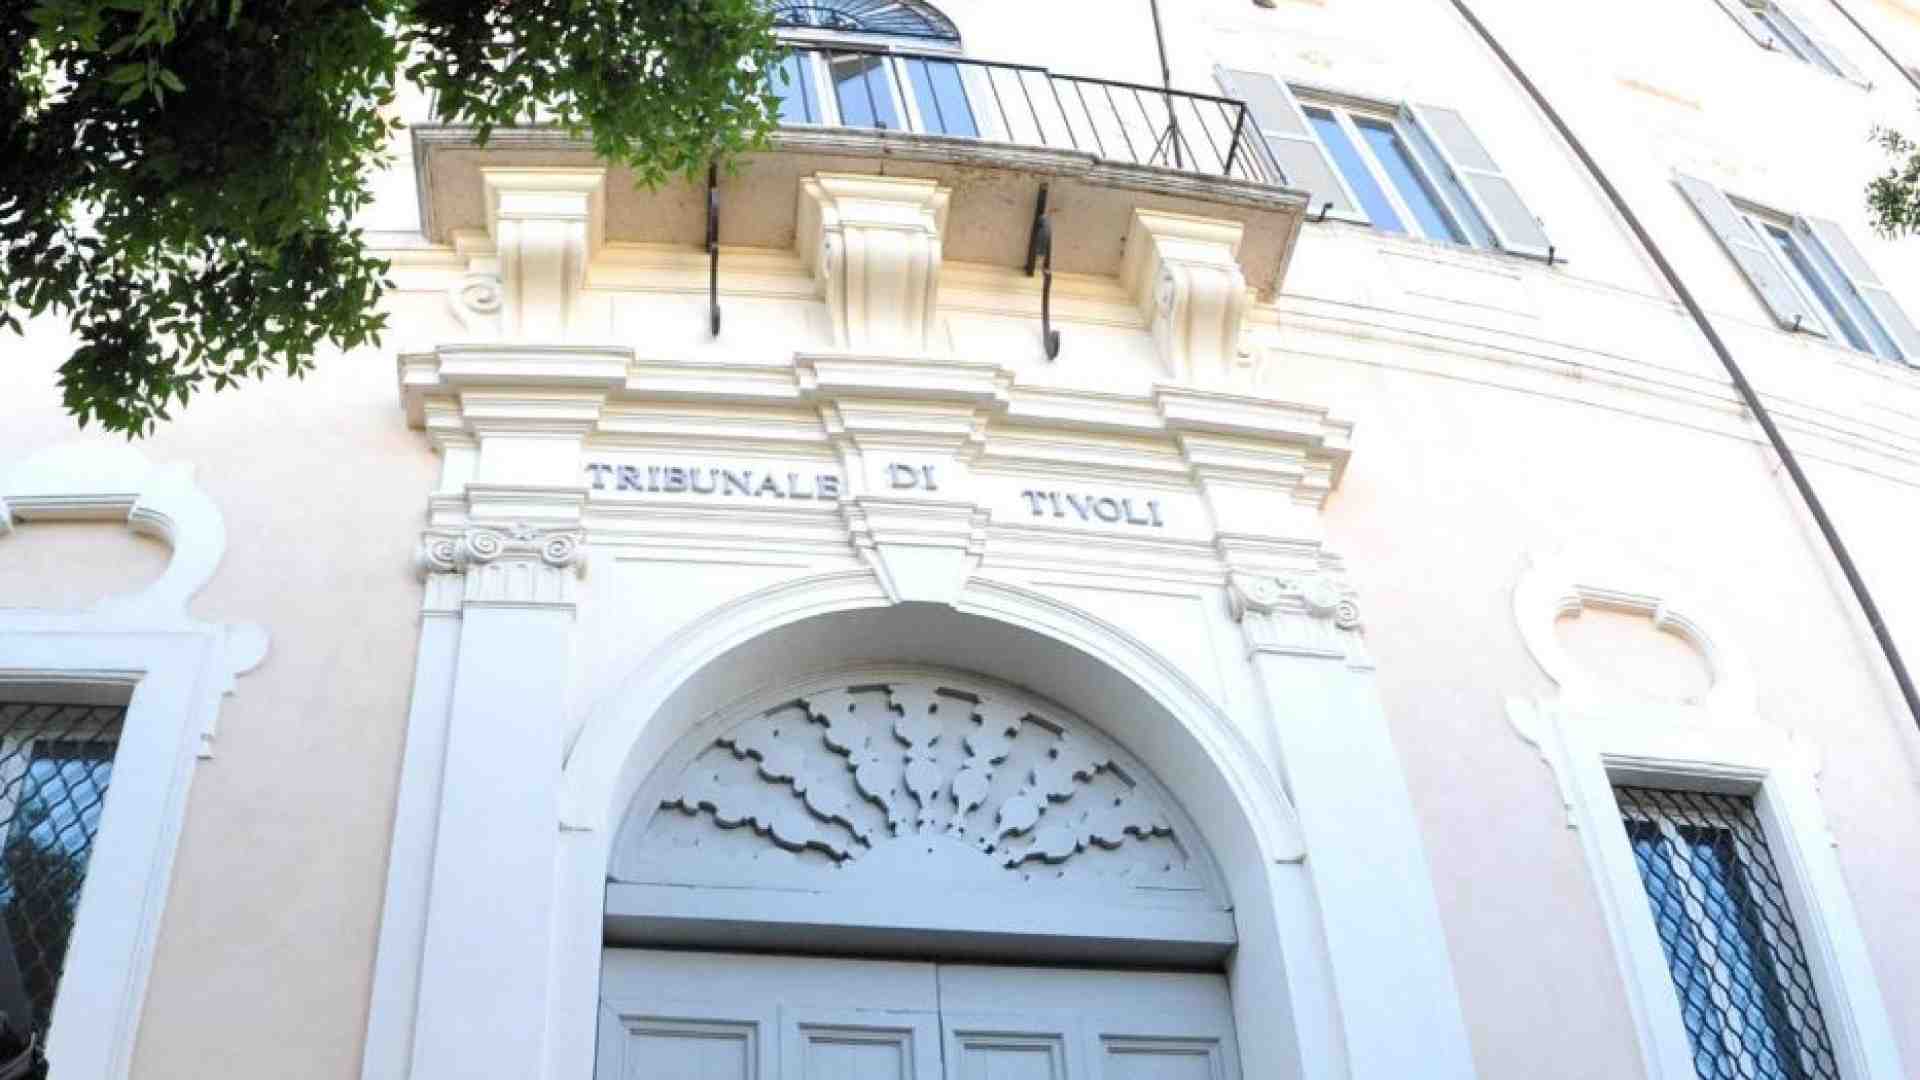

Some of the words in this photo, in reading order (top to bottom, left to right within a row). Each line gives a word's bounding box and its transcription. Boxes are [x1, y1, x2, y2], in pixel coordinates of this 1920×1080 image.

[586, 462, 839, 500] TRIBUNALE
[888, 462, 937, 491] DI
[1021, 489, 1163, 527] TIVOLI
